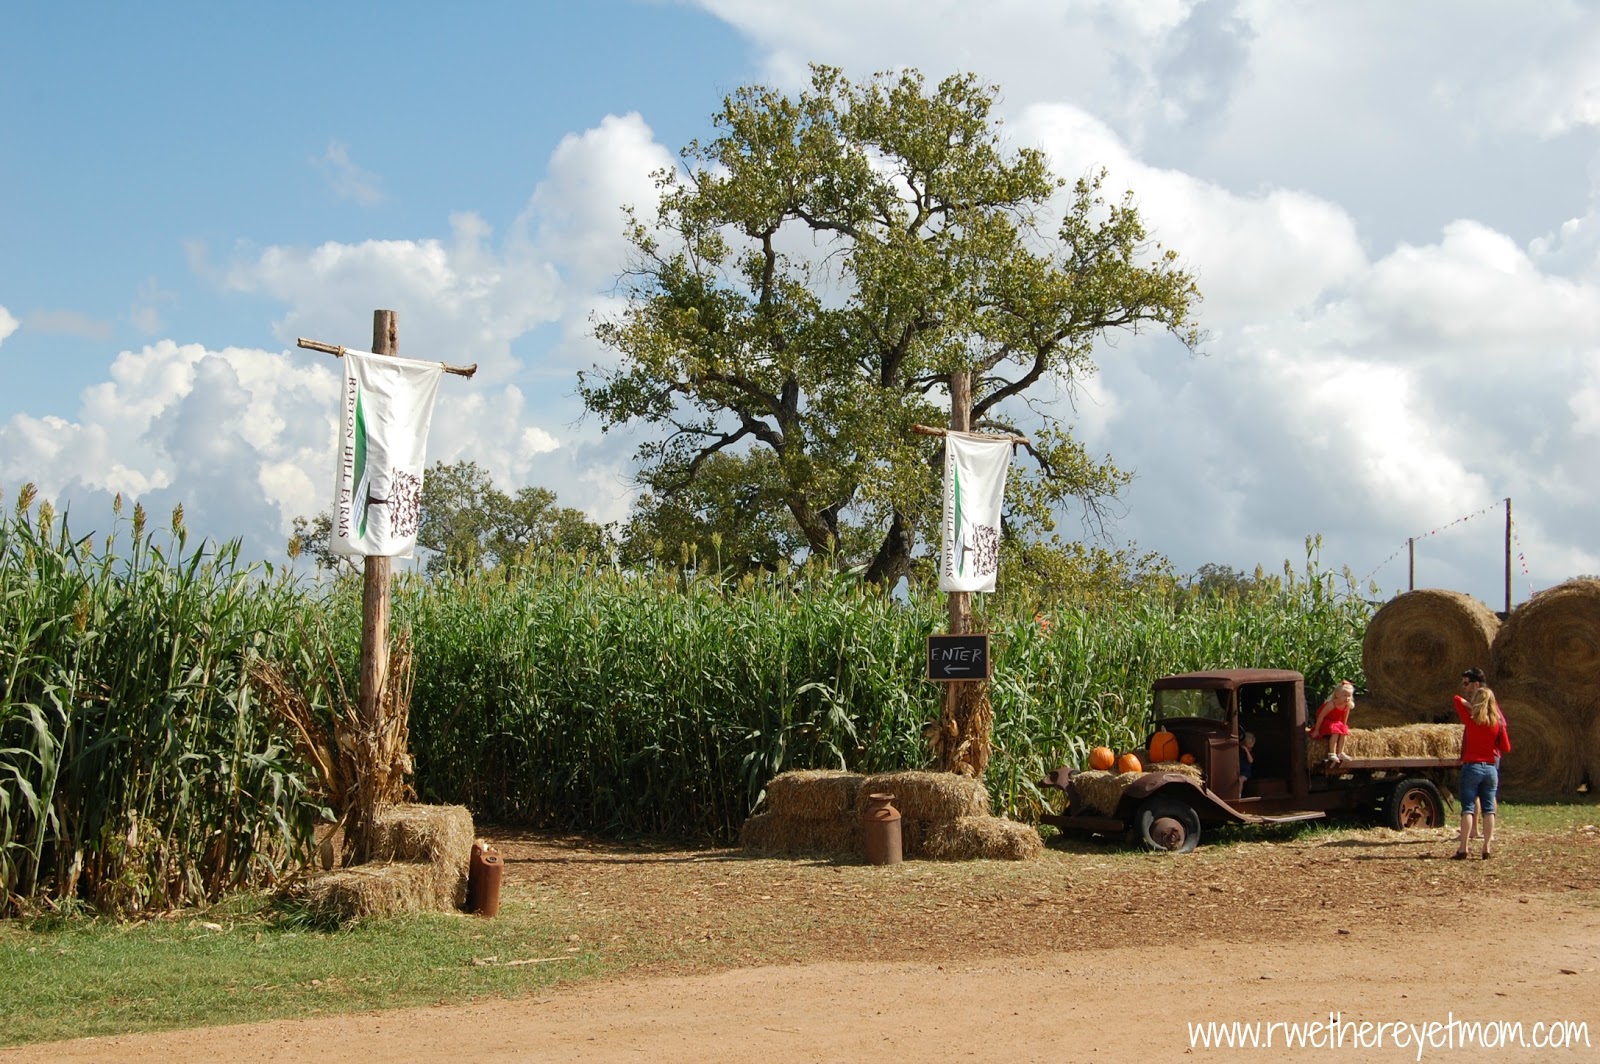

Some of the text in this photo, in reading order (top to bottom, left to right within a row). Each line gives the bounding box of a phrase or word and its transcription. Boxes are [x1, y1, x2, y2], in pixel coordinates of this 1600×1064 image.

[342, 445, 354, 482] HILL
[338, 489, 351, 538] FARMS
[945, 539, 954, 578] FARMS
[931, 646, 983, 663] ENTER
